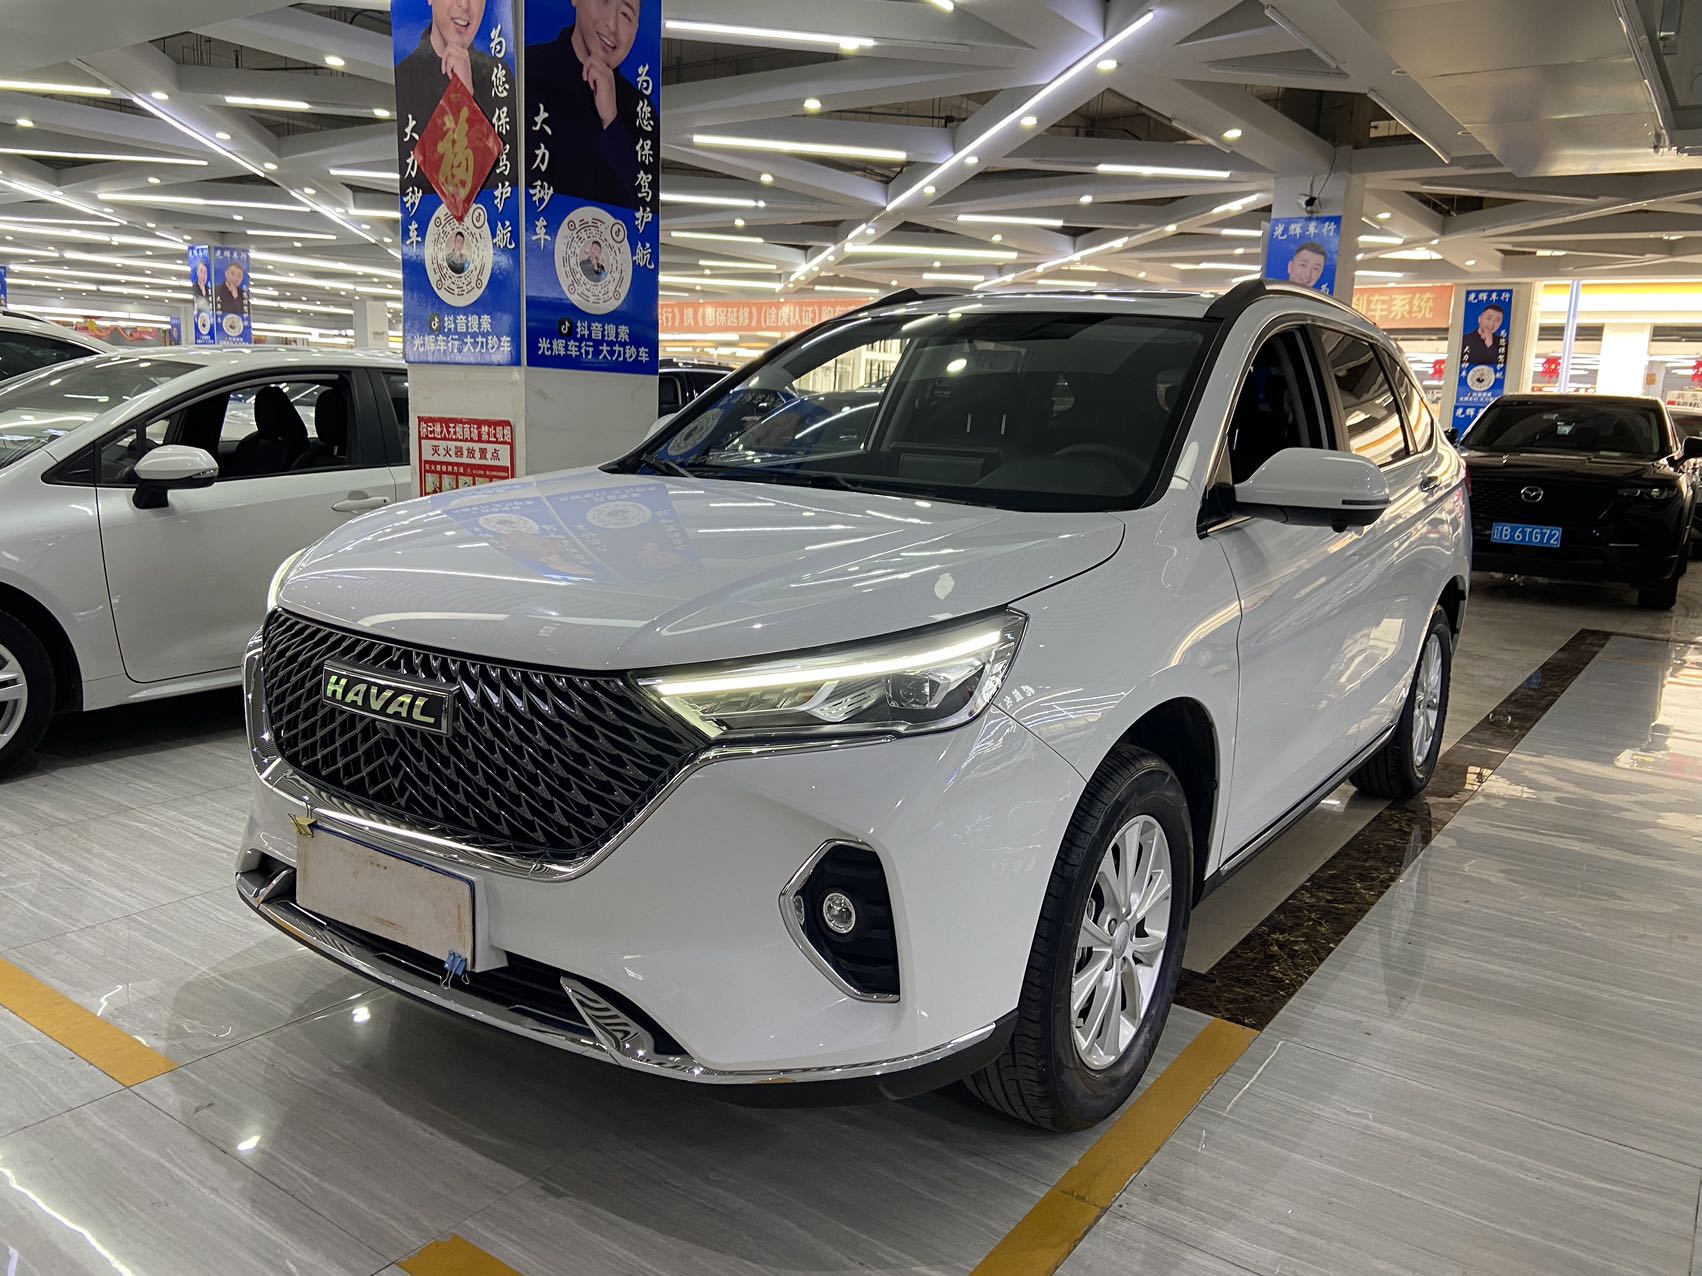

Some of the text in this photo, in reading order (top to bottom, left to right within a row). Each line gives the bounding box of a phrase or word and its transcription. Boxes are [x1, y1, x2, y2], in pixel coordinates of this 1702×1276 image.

[529, 103, 554, 250] 大力秒车
[632, 64, 655, 270] 为您保驾护航
[403, 114, 423, 252] 大力秒车
[1272, 220, 1337, 241] 光辉车行
[443, 314, 492, 333] 抖音搜索
[576, 320, 630, 342] 抖音搜索
[412, 334, 511, 353] 光辉车行 大力秒车
[537, 338, 650, 363] 光辉车行 大力秒车
[481, 425, 512, 442] 禁止吸烟
[431, 444, 501, 461] 灭火器放置点
[326, 675, 436, 724] HAVAL
